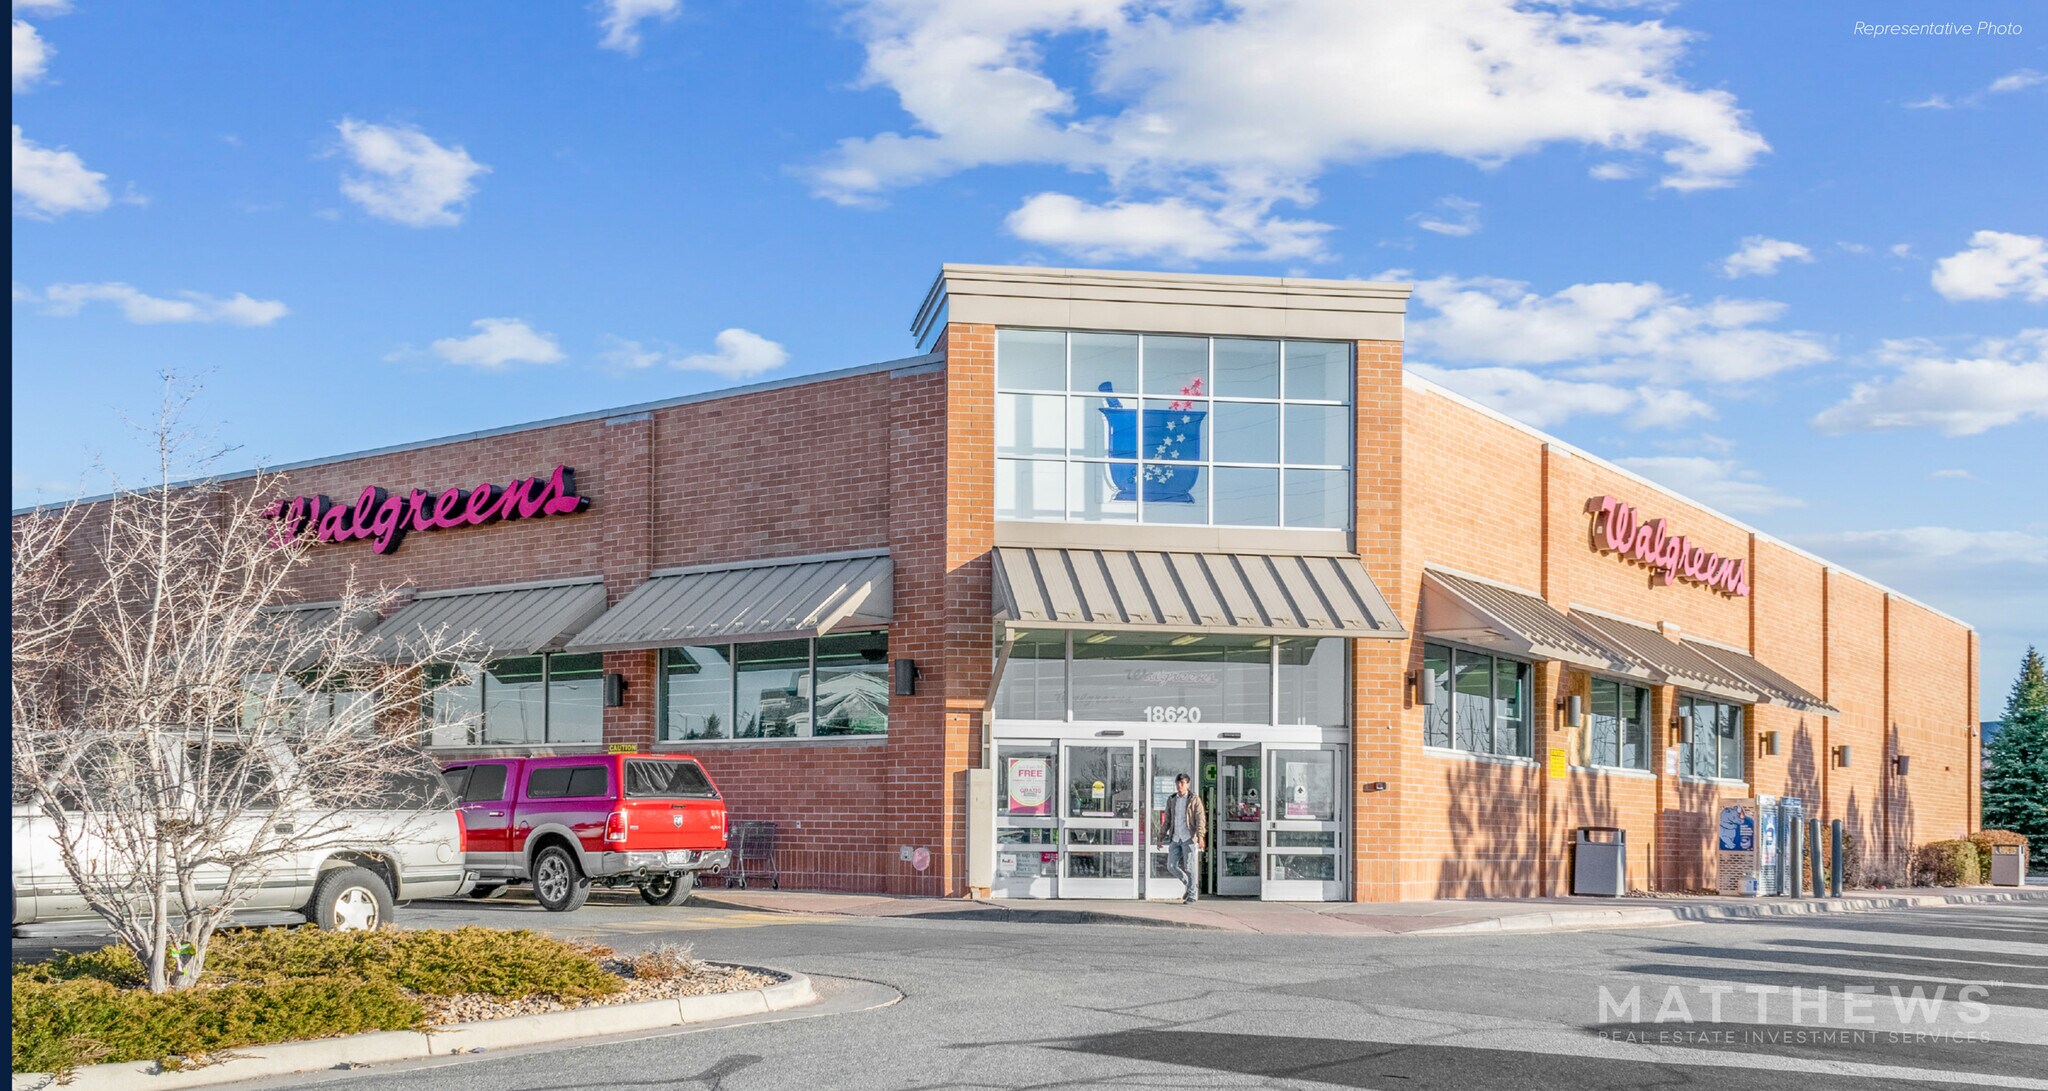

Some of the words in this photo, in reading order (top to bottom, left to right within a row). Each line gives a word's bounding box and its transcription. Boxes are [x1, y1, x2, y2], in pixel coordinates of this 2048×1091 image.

[262, 465, 588, 555] Walgreens
[1591, 495, 1750, 596] Walgreens
[1143, 706, 1201, 723] 18620
[609, 744, 637, 752] CAUTION
[1018, 769, 1043, 777] FREE
